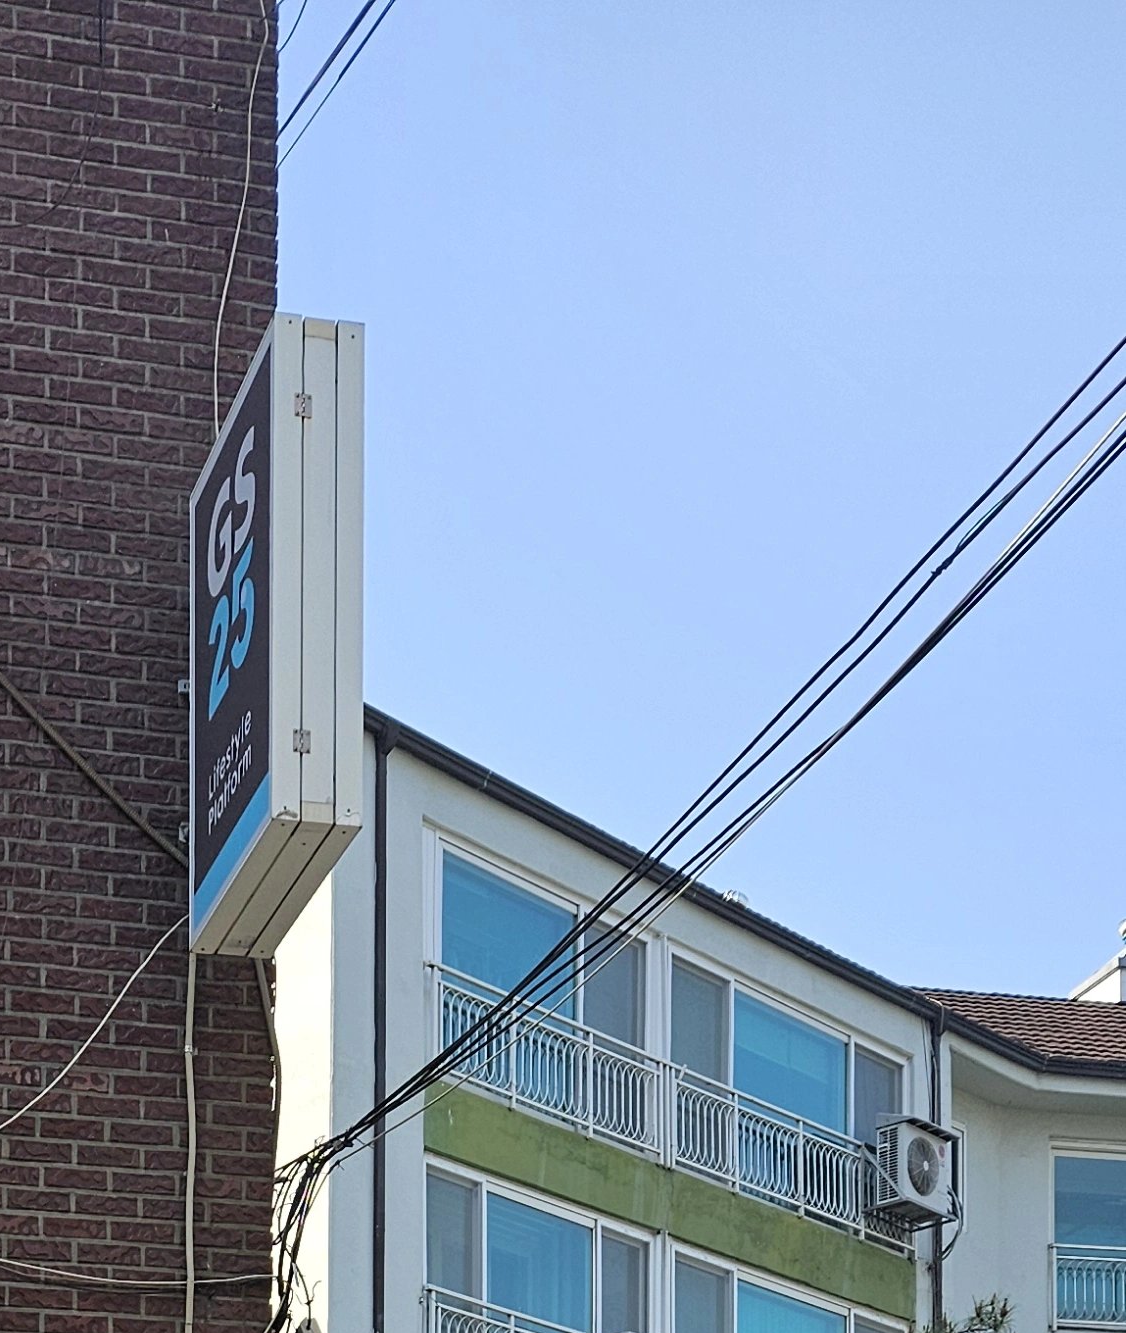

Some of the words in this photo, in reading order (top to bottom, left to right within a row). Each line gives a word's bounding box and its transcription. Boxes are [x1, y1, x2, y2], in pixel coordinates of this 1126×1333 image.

[207, 425, 256, 598] GS
[208, 536, 255, 721] 25
[208, 710, 252, 801] Lifestyle
[208, 743, 252, 836] Platform
